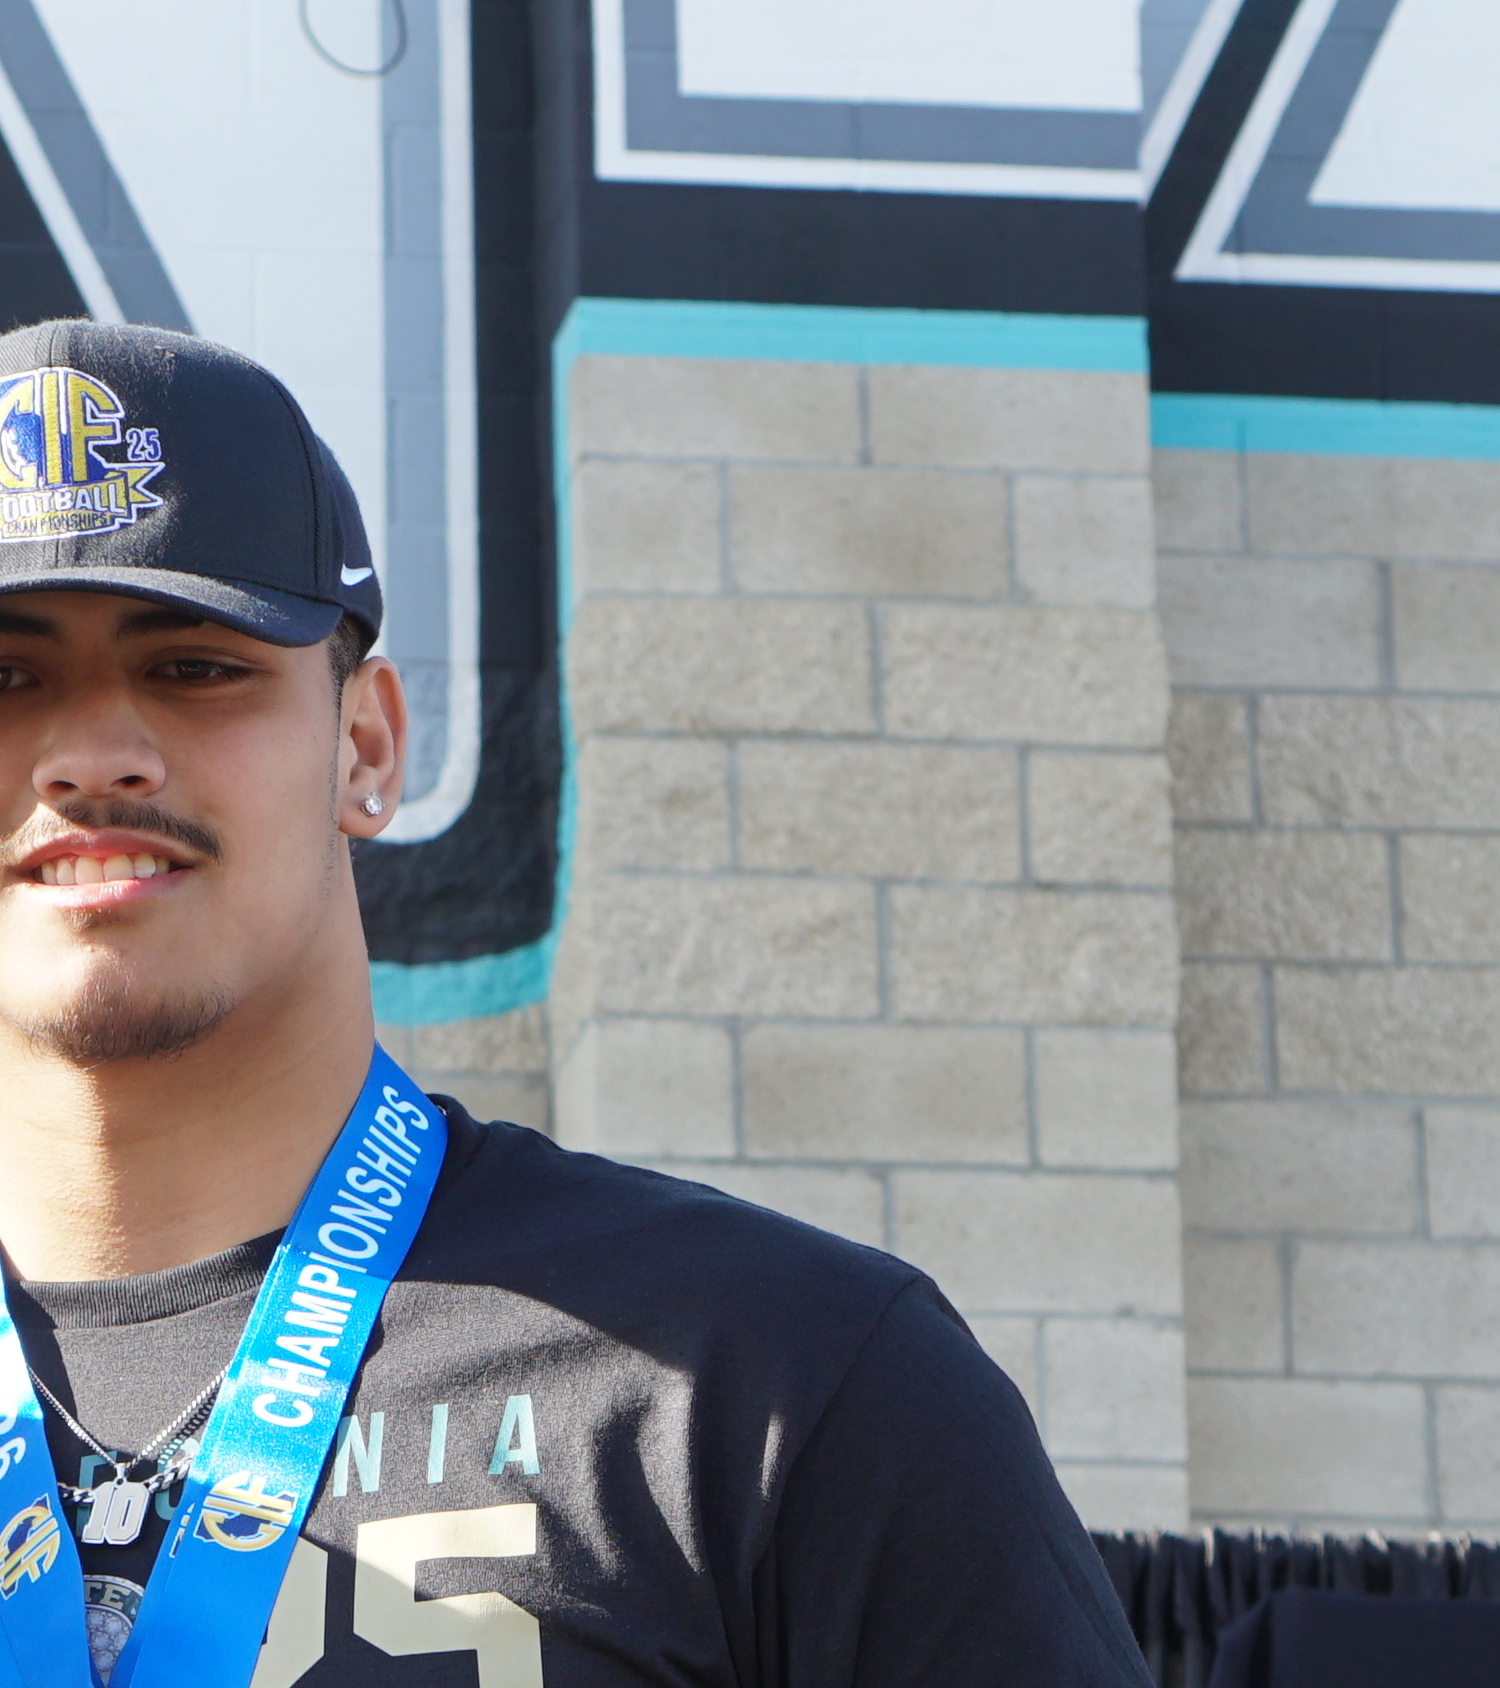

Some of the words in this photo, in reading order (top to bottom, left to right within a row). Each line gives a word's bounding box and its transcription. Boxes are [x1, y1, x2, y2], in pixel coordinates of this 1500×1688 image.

[126, 428, 161, 461] 25
[251, 1085, 430, 1428] CHAMPIONSHIPS
[85, 1481, 149, 1545] 10
